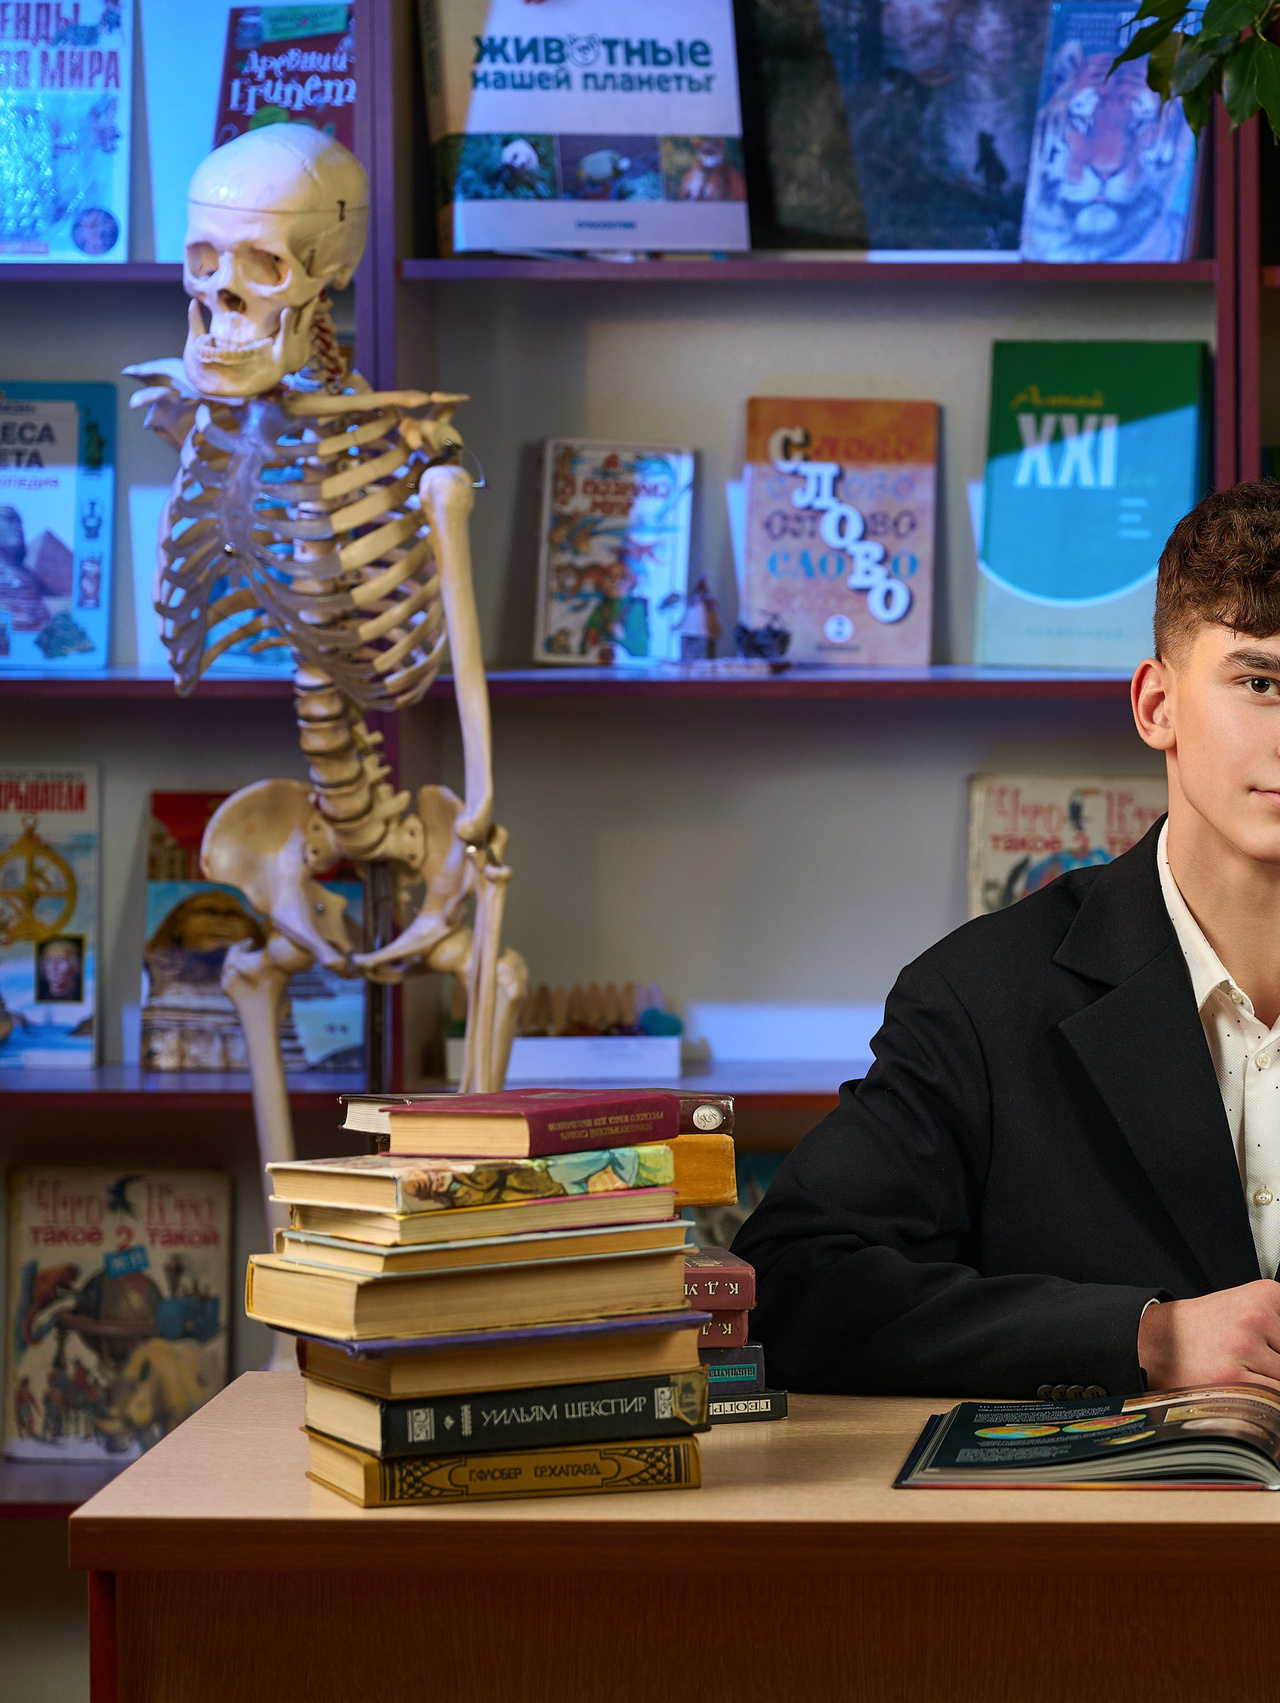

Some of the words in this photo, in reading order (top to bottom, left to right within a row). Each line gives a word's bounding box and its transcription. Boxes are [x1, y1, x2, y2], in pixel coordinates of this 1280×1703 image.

[1013, 413, 1119, 488] XXI
[704, 1281, 719, 1296] Д.
[724, 1282, 740, 1295] К.
[717, 1322, 732, 1336] К.
[708, 1366, 756, 1379] БИБЛИОТЕ
[481, 1406, 558, 1428] УИЛЬЯМ
[565, 1396, 648, 1420] ШЕКСПИР
[708, 1399, 771, 1414] ГЕОГР
